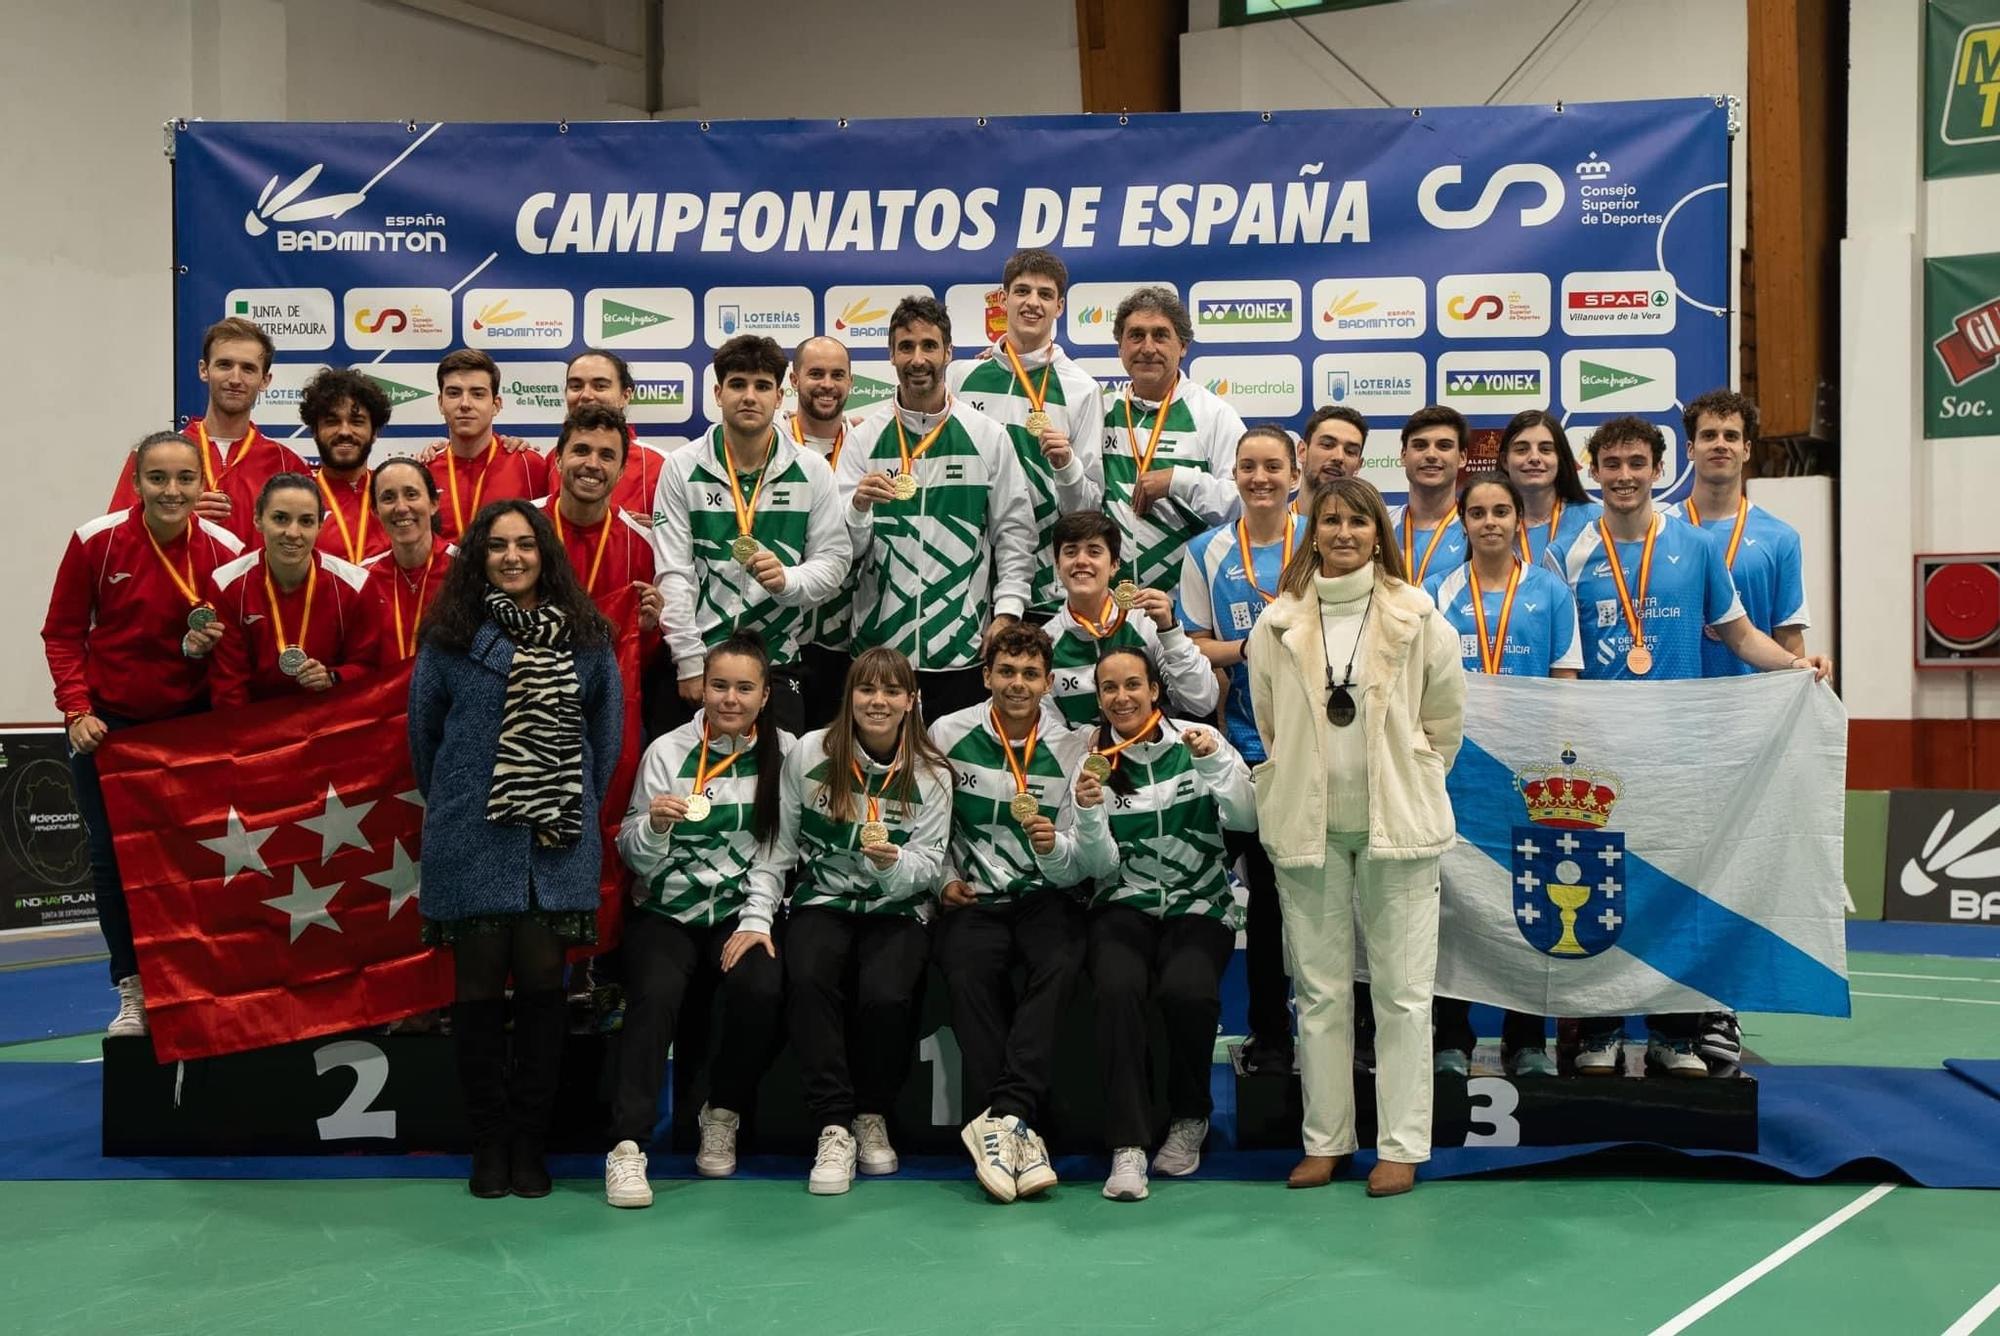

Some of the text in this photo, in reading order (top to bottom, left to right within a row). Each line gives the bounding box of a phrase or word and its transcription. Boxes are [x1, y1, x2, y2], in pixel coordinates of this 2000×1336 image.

[1580, 184, 1637, 198] Consejo
[515, 162, 1370, 254] CAMPEONATOS DE ESPAÑA
[1581, 198, 1640, 213] Superior
[386, 213, 446, 226] ESPAÑA
[1581, 213, 1663, 227] de Deportes
[277, 230, 447, 253] BADMINTON
[1584, 293, 1648, 306] SPAR
[252, 305, 301, 319] JUNTA DE
[744, 310, 801, 323] LOTERÍAS
[1235, 302, 1287, 320] YONEX
[1569, 311, 1661, 321] Villanueva de la Vera
[257, 322, 327, 335] XTREMADURA
[1338, 318, 1416, 329] BADMINTON
[487, 326, 562, 337] BADMINTON
[502, 381, 559, 395] La Quesera
[1231, 380, 1295, 394] Iberdrola
[1354, 377, 1411, 389] LOTERÍAS
[1483, 374, 1535, 390] YONEX
[265, 389, 302, 399] LOTER
[516, 394, 562, 407] de la Vera
[1939, 395, 1993, 418] Soc.
[919, 1026, 962, 1125] 1
[313, 1040, 397, 1140] 2
[1465, 1077, 1520, 1147] 3
